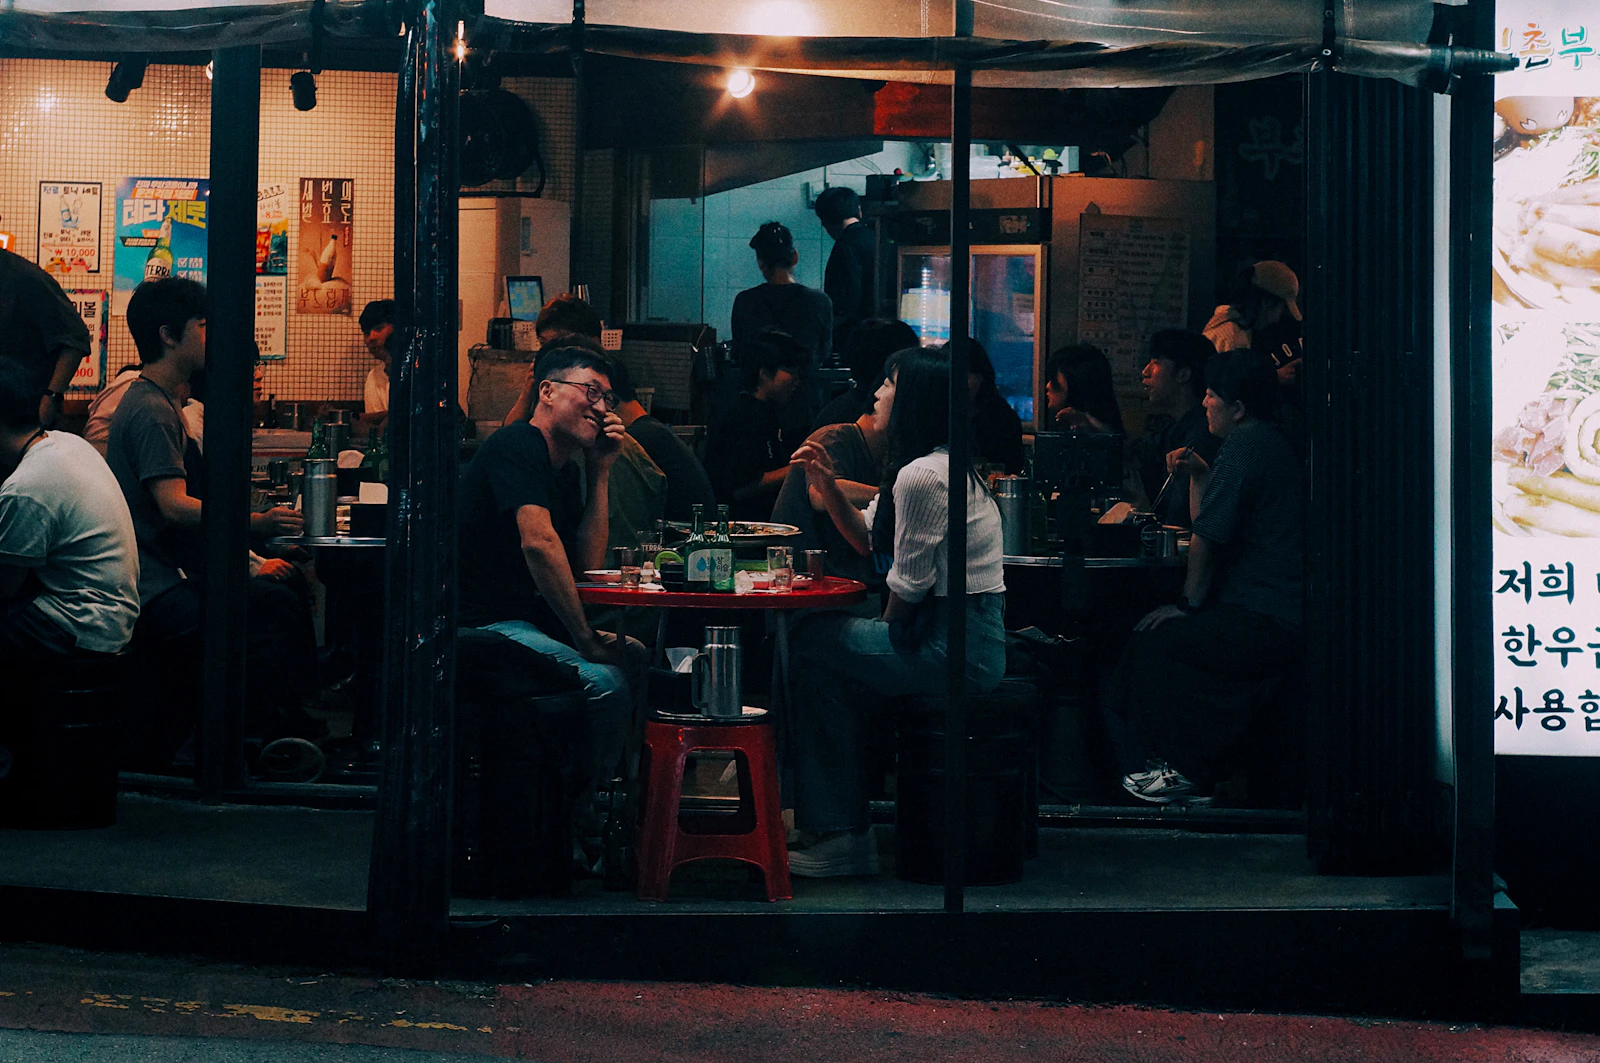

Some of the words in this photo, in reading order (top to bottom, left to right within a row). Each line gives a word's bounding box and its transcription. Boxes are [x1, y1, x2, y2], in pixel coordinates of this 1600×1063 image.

[1501, 22, 1593, 69] 촌부
[302, 180, 313, 201] 세
[122, 199, 165, 226] 테라
[167, 200, 206, 229] 제로
[301, 203, 351, 224] 발효로
[66, 248, 96, 257] 10,000
[1495, 560, 1574, 605] 저희
